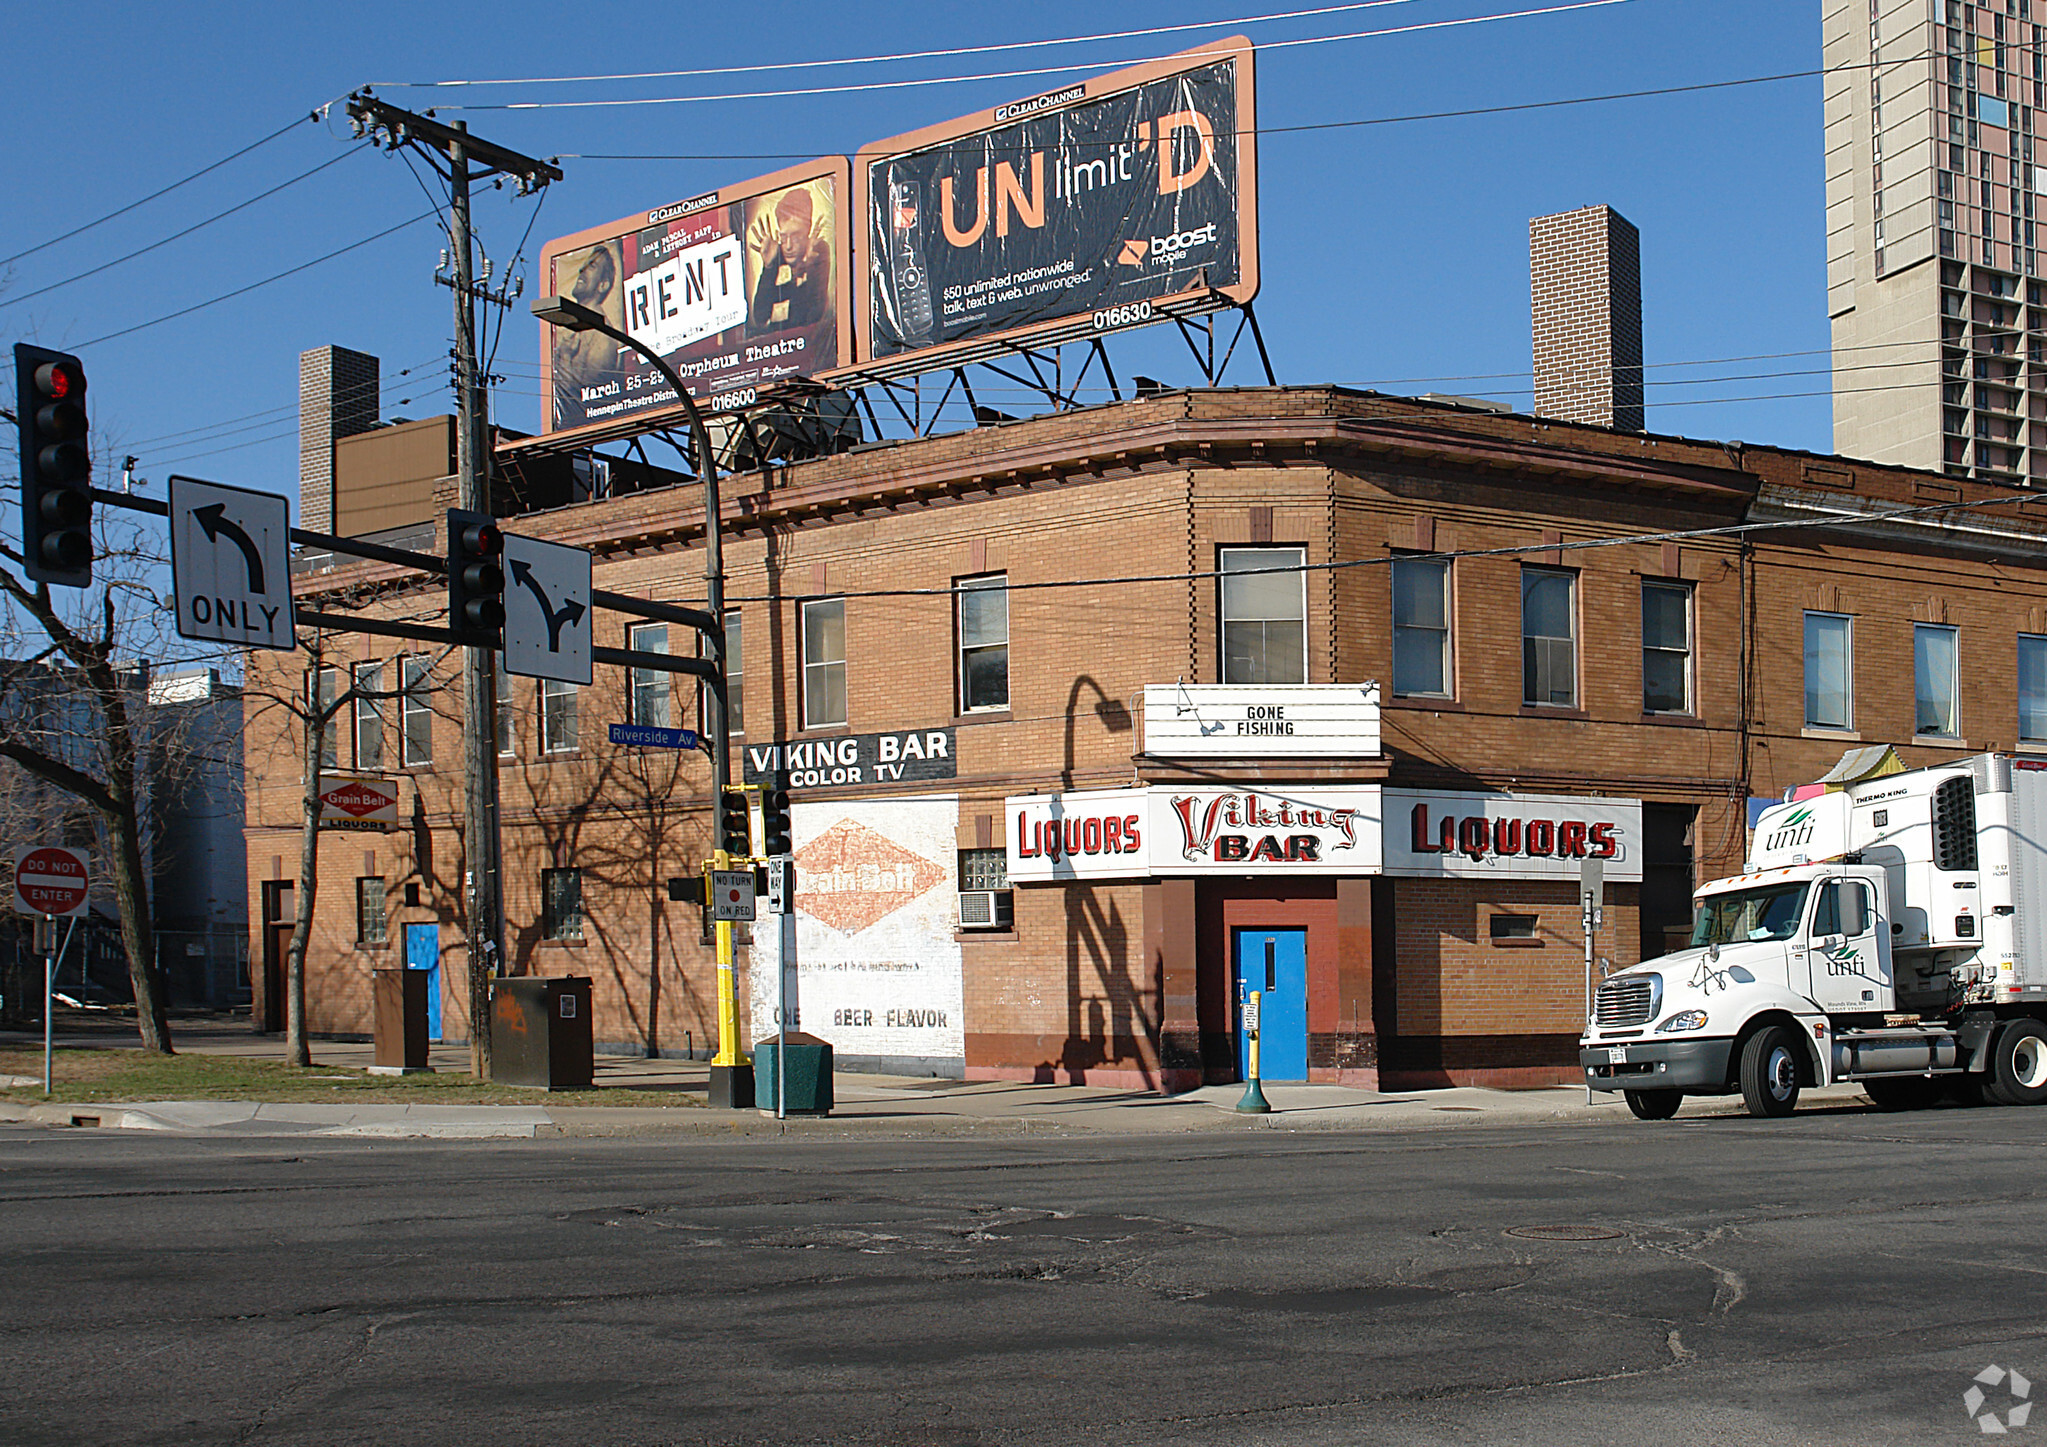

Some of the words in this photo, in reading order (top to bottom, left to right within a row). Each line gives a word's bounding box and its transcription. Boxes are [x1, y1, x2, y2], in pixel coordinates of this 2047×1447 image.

[1151, 221, 1217, 255] boost
[630, 250, 733, 332] RENT
[943, 285, 962, 301] $50
[963, 272, 1012, 296] unlimited
[1013, 259, 1074, 285] nationwide
[943, 300, 966, 316] talk,
[966, 293, 987, 310] text
[988, 292, 996, 305] &
[997, 286, 1024, 303] web.
[1093, 301, 1151, 329] 016630
[581, 380, 620, 402] March
[680, 352, 740, 378] Orpheum
[746, 335, 805, 364] Theatre
[711, 388, 756, 412] 016600
[192, 595, 280, 634] ONLY
[1247, 706, 1284, 720] GONE
[612, 728, 669, 745] Riverside
[678, 733, 694, 745] Av
[1237, 721, 1294, 736] FISHING
[750, 739, 858, 773] VIKING
[879, 731, 949, 763] BAR
[790, 768, 862, 788] COLOR
[873, 763, 905, 782] TV
[327, 792, 361, 805] Grain
[362, 794, 386, 806] Belt
[1856, 792, 1886, 805] THERMO
[1887, 788, 1908, 798] KING
[330, 819, 387, 830] LIQUORS
[1170, 793, 1361, 863] Viking
[1411, 803, 1618, 863] LIQUORS
[1018, 810, 1142, 864] LIQUORS
[1213, 833, 1322, 863] BAR
[28, 859, 46, 871] DO
[52, 861, 77, 874] NOT
[770, 860, 782, 874] ONE
[716, 875, 728, 886] NO
[731, 875, 752, 886] TURN
[770, 876, 782, 890] WAY
[32, 888, 73, 902] ENTER
[720, 905, 731, 915] ON
[735, 905, 751, 916] RED
[1826, 954, 1866, 977] unfi
[834, 1008, 873, 1027] BEER
[886, 1008, 948, 1028] FLAVOR
